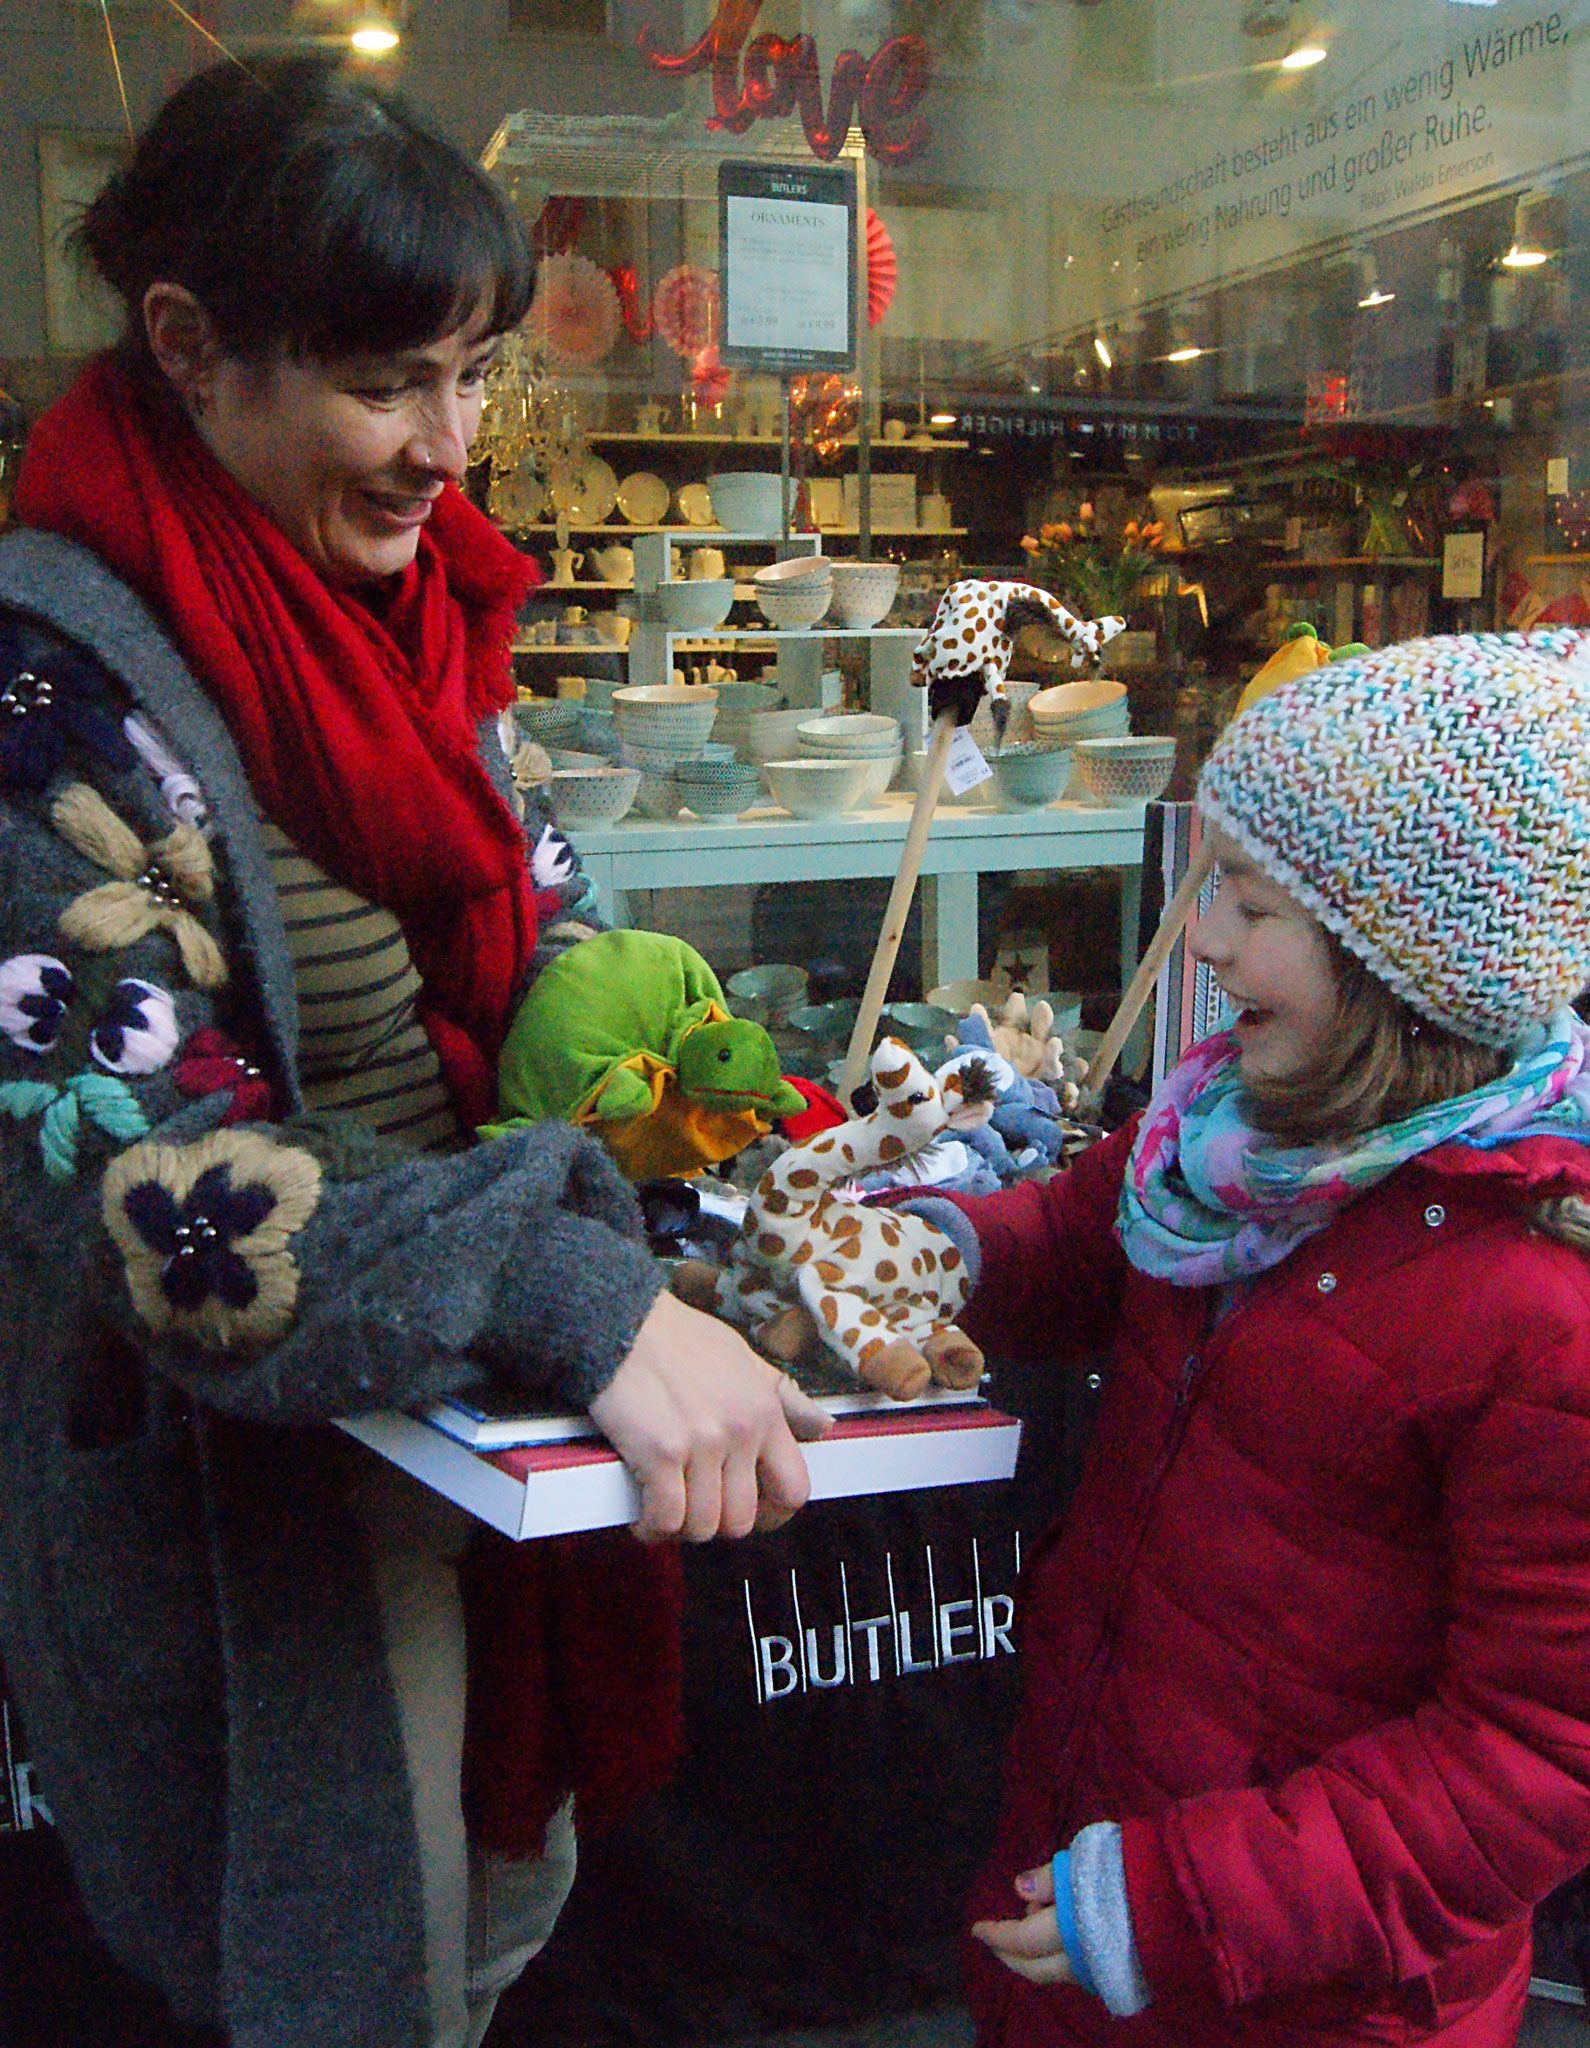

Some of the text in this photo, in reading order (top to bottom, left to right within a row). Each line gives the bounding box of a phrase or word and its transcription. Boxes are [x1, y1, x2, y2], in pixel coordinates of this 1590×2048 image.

[1231, 126, 1298, 178] besteht
[1303, 111, 1340, 148] aus
[1345, 95, 1376, 130] ein
[1384, 58, 1455, 113] wenig
[1463, 12, 1569, 78] Wärme,
[771, 182, 808, 195] BUTLERS
[1214, 183, 1292, 231] Nahrung
[1298, 156, 1336, 201] und
[1344, 129, 1417, 194] großer
[1424, 101, 1494, 152] Ruhe.
[1438, 151, 1495, 185] Emerson
[750, 212, 826, 228] ORNAMENTS
[759, 1592, 1020, 1702] BUTLER
